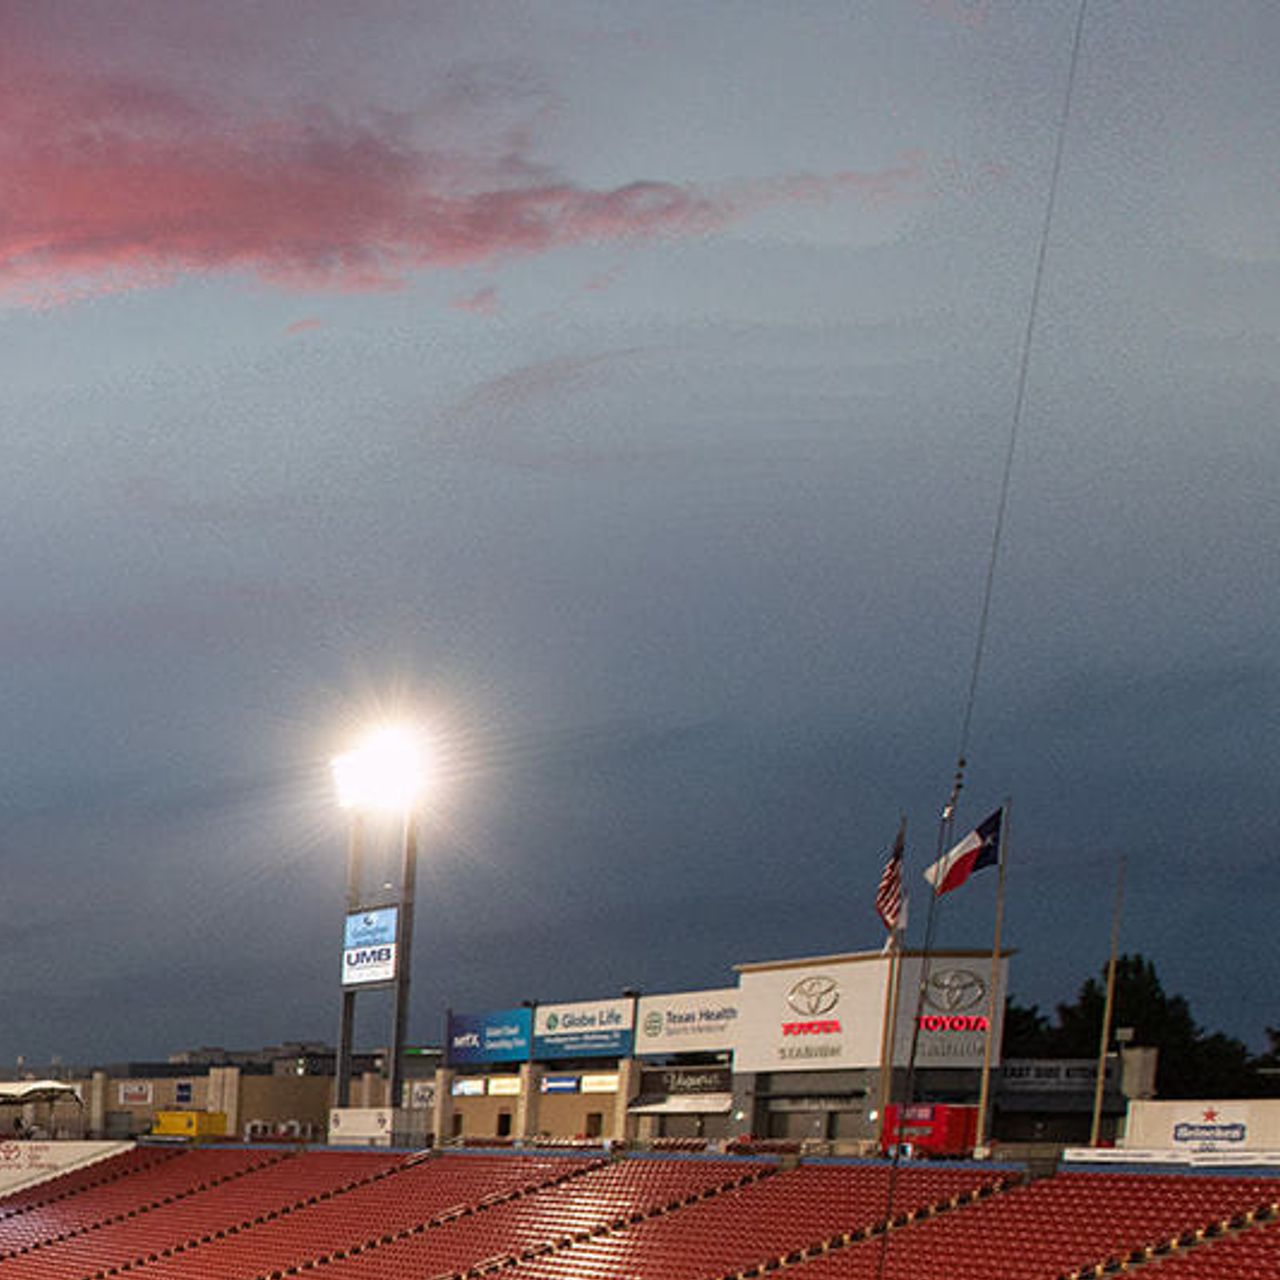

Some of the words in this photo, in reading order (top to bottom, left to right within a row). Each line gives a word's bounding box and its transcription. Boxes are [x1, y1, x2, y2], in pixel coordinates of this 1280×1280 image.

[346, 948, 391, 966] UMB
[561, 1012, 596, 1027] Globe
[599, 1009, 622, 1025] Life
[916, 1015, 990, 1032] TOYOTA
[782, 1020, 842, 1036] TOYOTA
